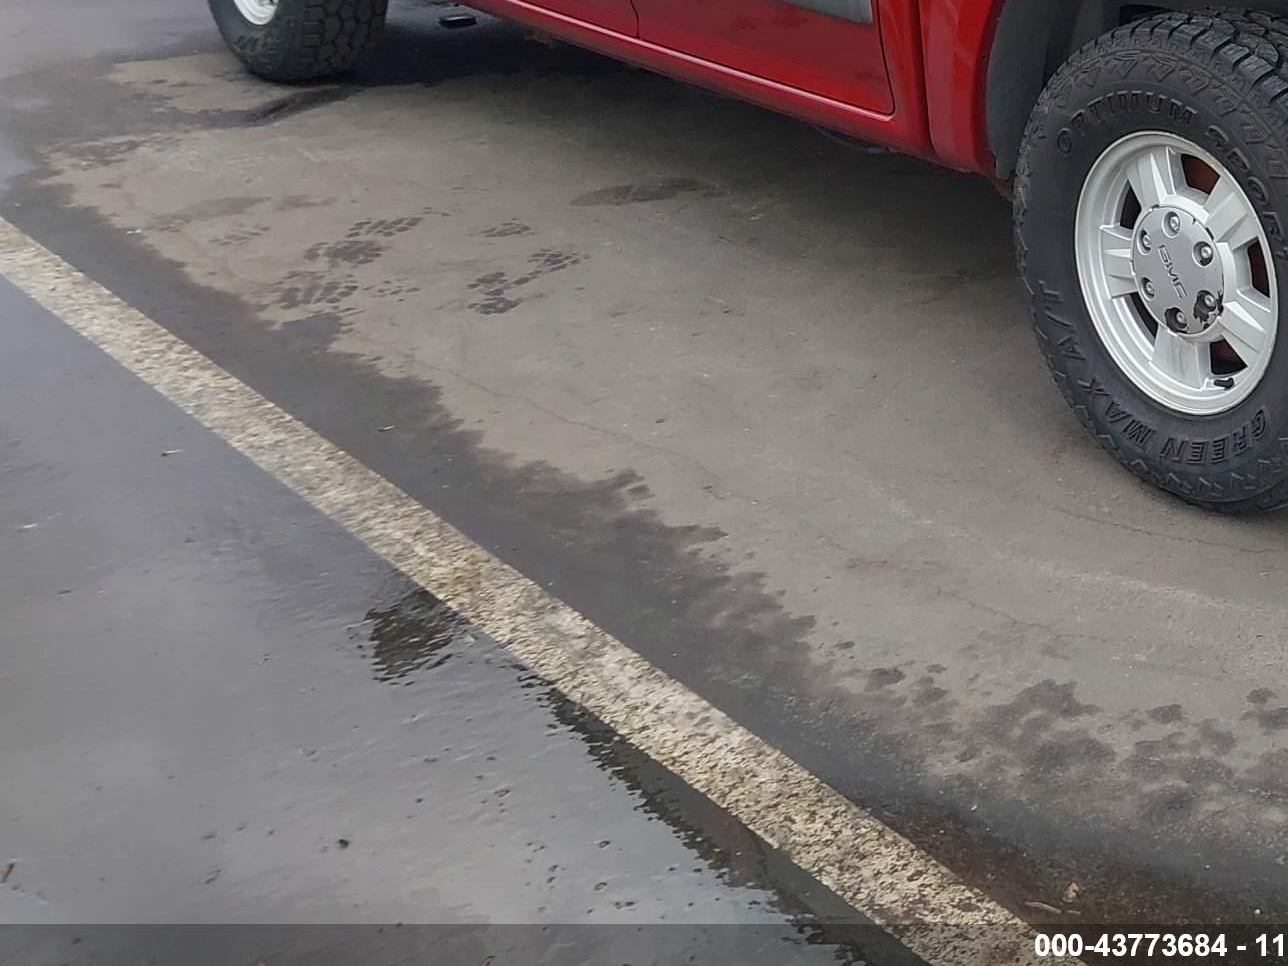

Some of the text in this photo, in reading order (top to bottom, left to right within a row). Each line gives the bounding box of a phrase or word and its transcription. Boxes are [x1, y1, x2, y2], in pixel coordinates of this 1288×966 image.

[1057, 90, 1198, 154] OPTIMUM
[1157, 244, 1187, 299] GMC
[1076, 378, 1157, 447] MAX
[1160, 408, 1268, 465] GREEN
